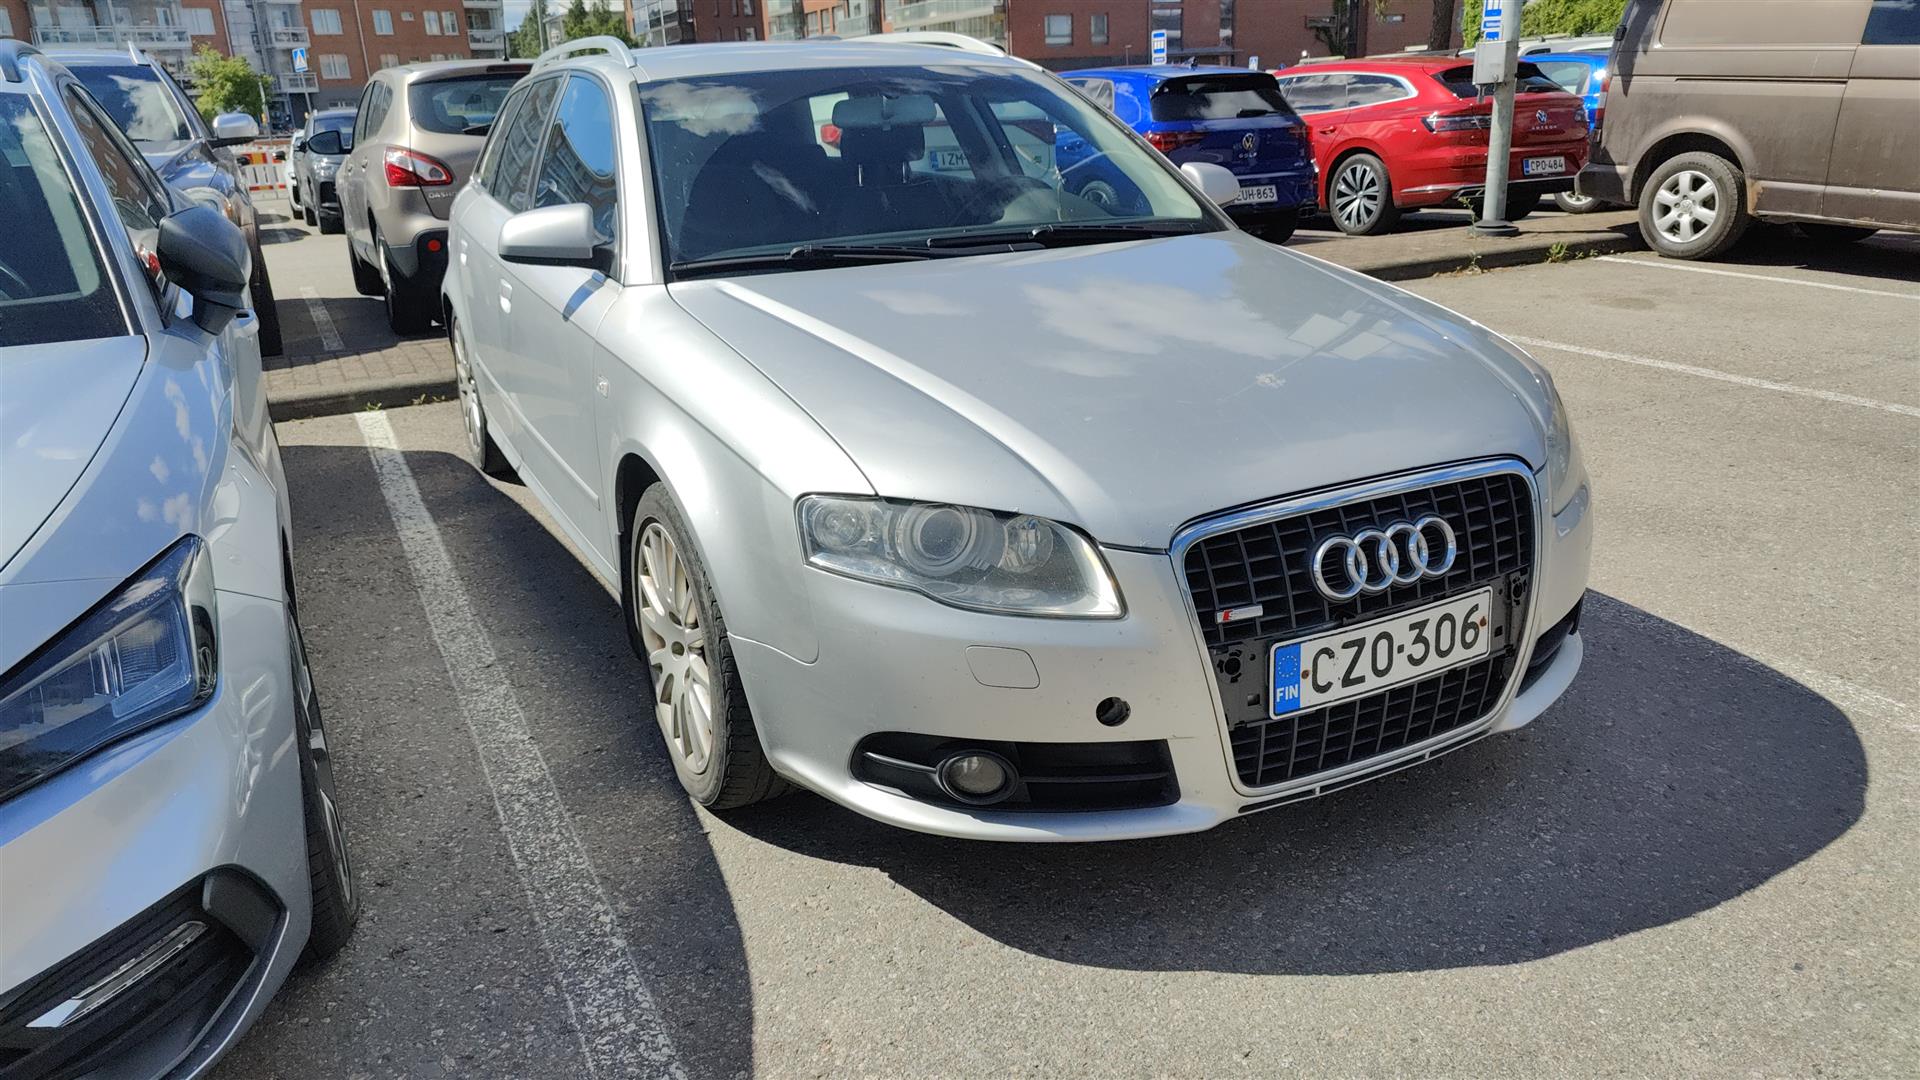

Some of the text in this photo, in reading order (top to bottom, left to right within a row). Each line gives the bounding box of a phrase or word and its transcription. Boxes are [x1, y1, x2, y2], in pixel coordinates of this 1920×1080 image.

[1530, 159, 1563, 171] CPO-484
[1311, 603, 1480, 694] CZO-306
[1276, 684, 1299, 702] FIN
